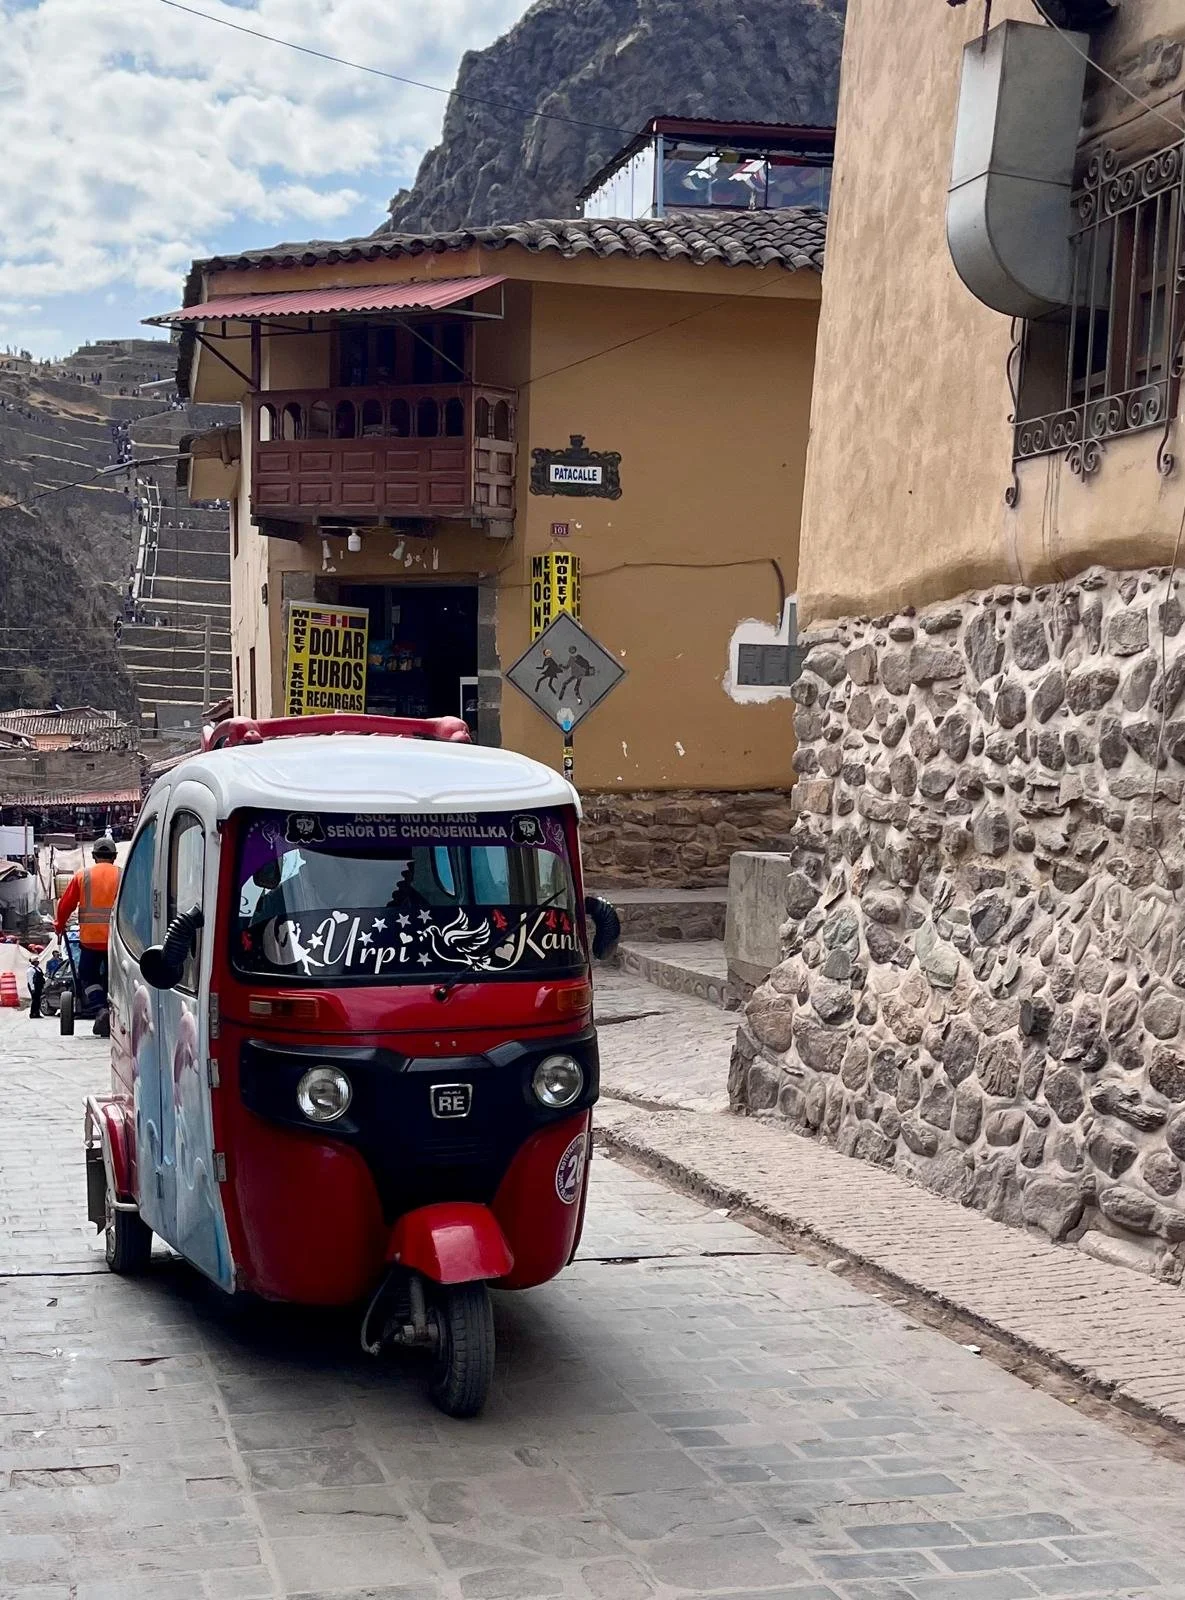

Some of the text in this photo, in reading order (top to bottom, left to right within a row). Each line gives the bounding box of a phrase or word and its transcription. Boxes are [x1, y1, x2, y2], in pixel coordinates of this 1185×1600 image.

[554, 467, 597, 481] PATACALLE
[554, 526, 567, 535] 101
[555, 555, 569, 605] MONEY
[309, 627, 364, 660] DOLAR
[289, 609, 309, 717] MONEY EXCHAN
[308, 658, 364, 691] EUROS
[306, 690, 363, 711] RECARGAS
[327, 823, 507, 838] SEÑOR DE CHOQUEKILLKA
[316, 916, 411, 974] Urpi
[438, 1096, 465, 1112] RE
